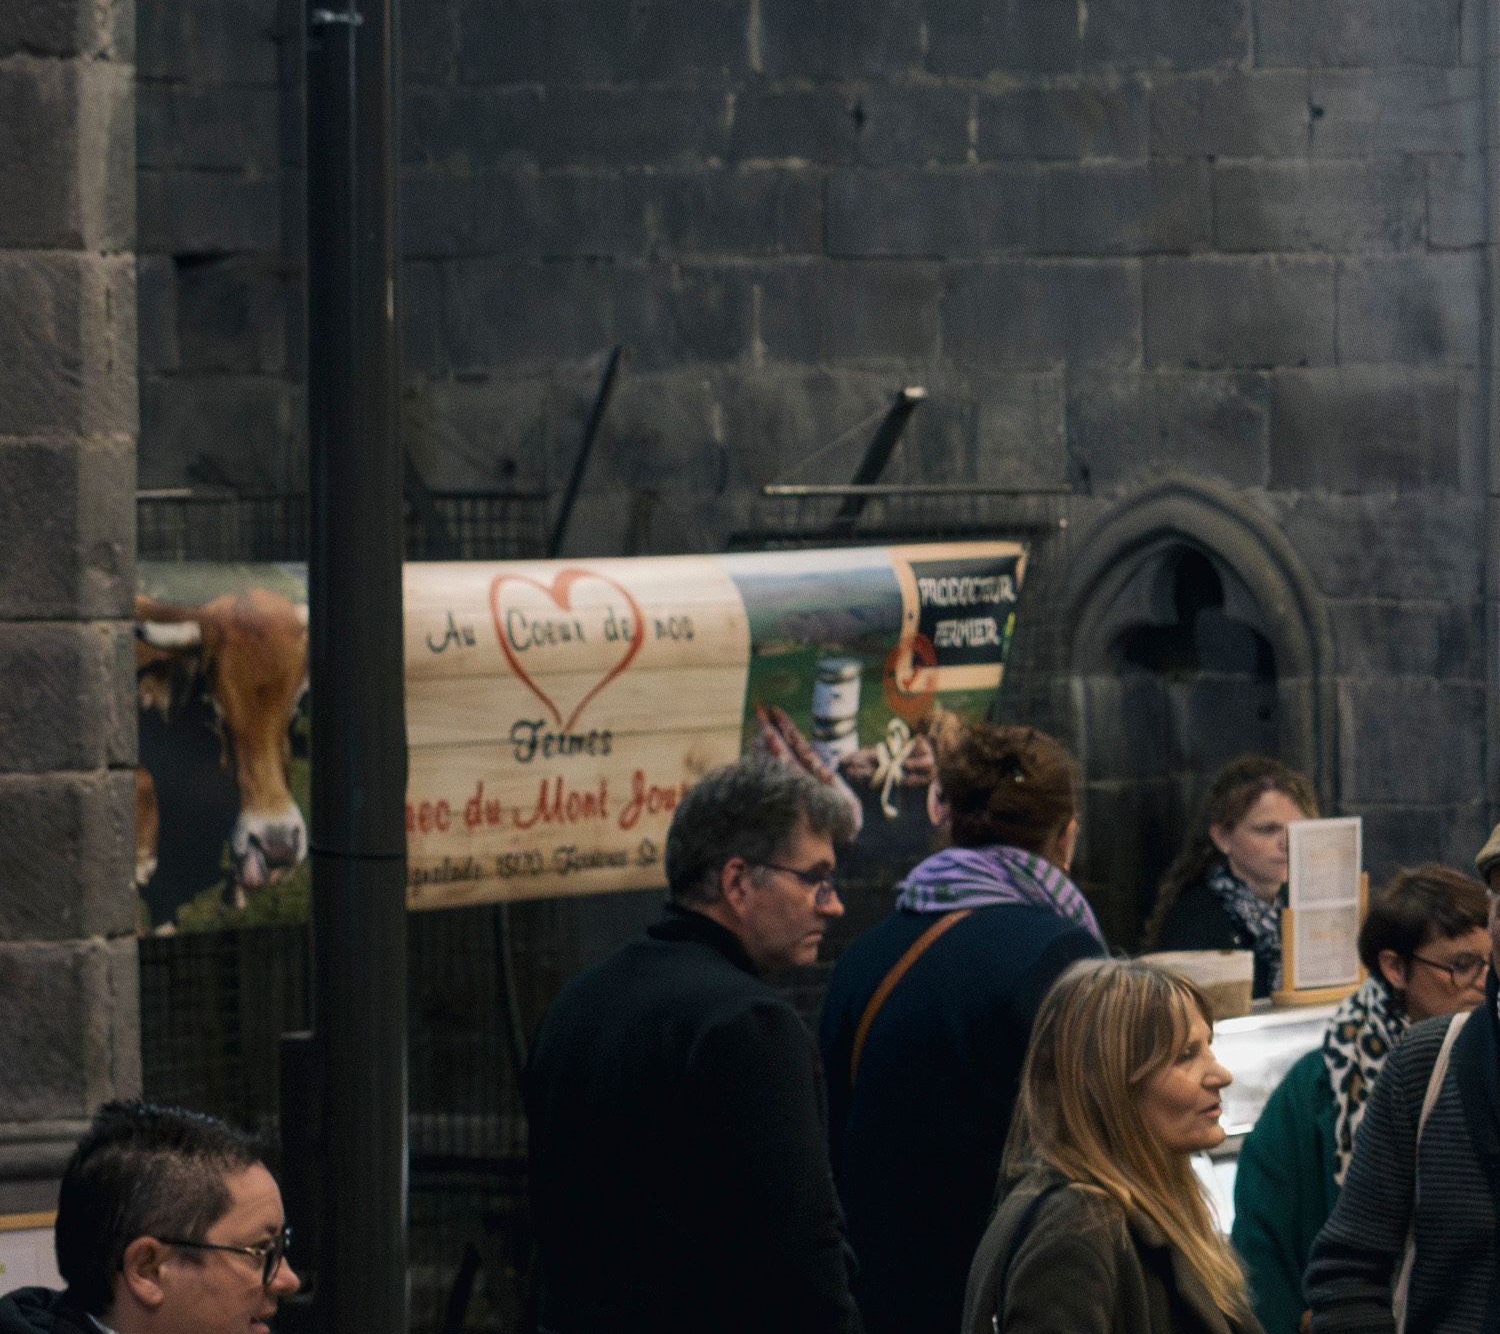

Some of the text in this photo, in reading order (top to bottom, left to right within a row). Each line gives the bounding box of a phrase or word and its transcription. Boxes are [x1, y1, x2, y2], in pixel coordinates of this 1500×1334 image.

[505, 606, 588, 652] Coeur
[509, 717, 613, 765] Fermes
[463, 779, 501, 831] du
[511, 775, 611, 831] Mont
